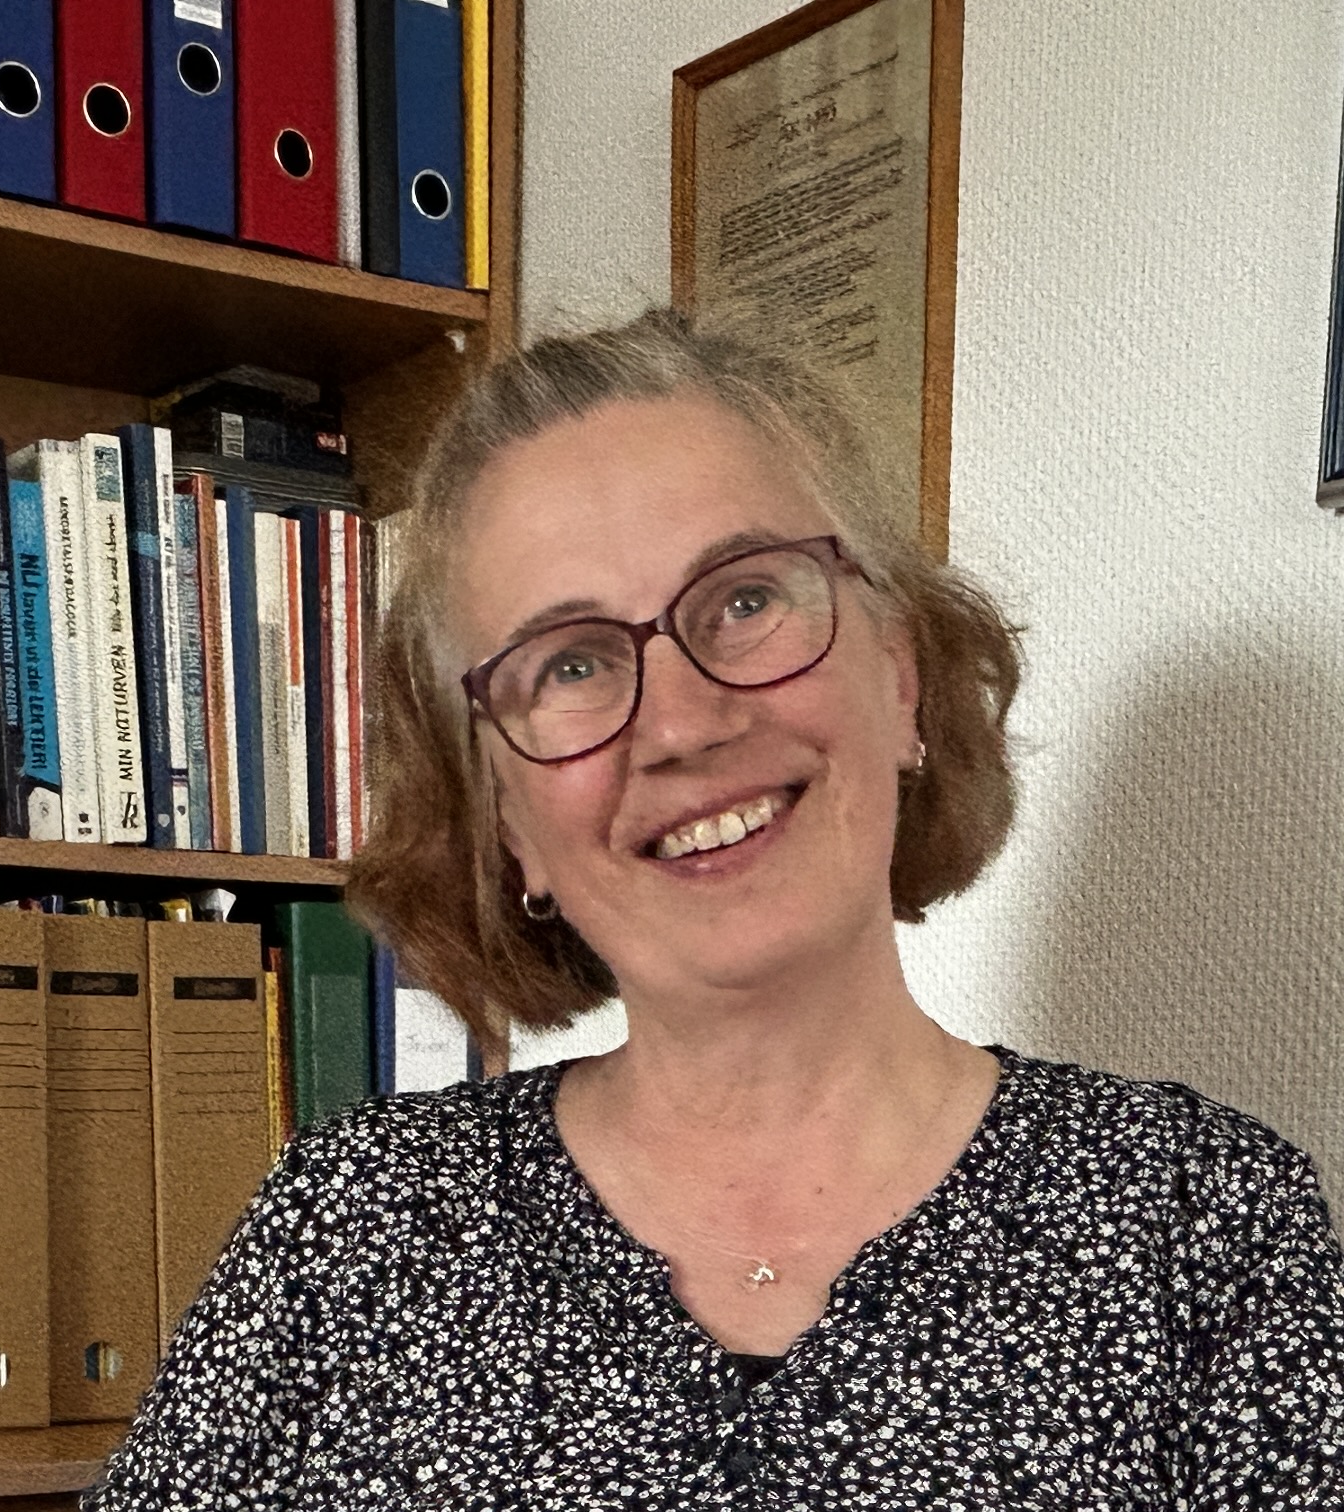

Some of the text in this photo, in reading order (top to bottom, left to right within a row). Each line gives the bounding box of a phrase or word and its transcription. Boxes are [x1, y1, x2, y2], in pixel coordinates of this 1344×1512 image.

[20, 552, 42, 588] NU
[109, 644, 131, 741] NATURVEN
[118, 747, 134, 780] MIN
